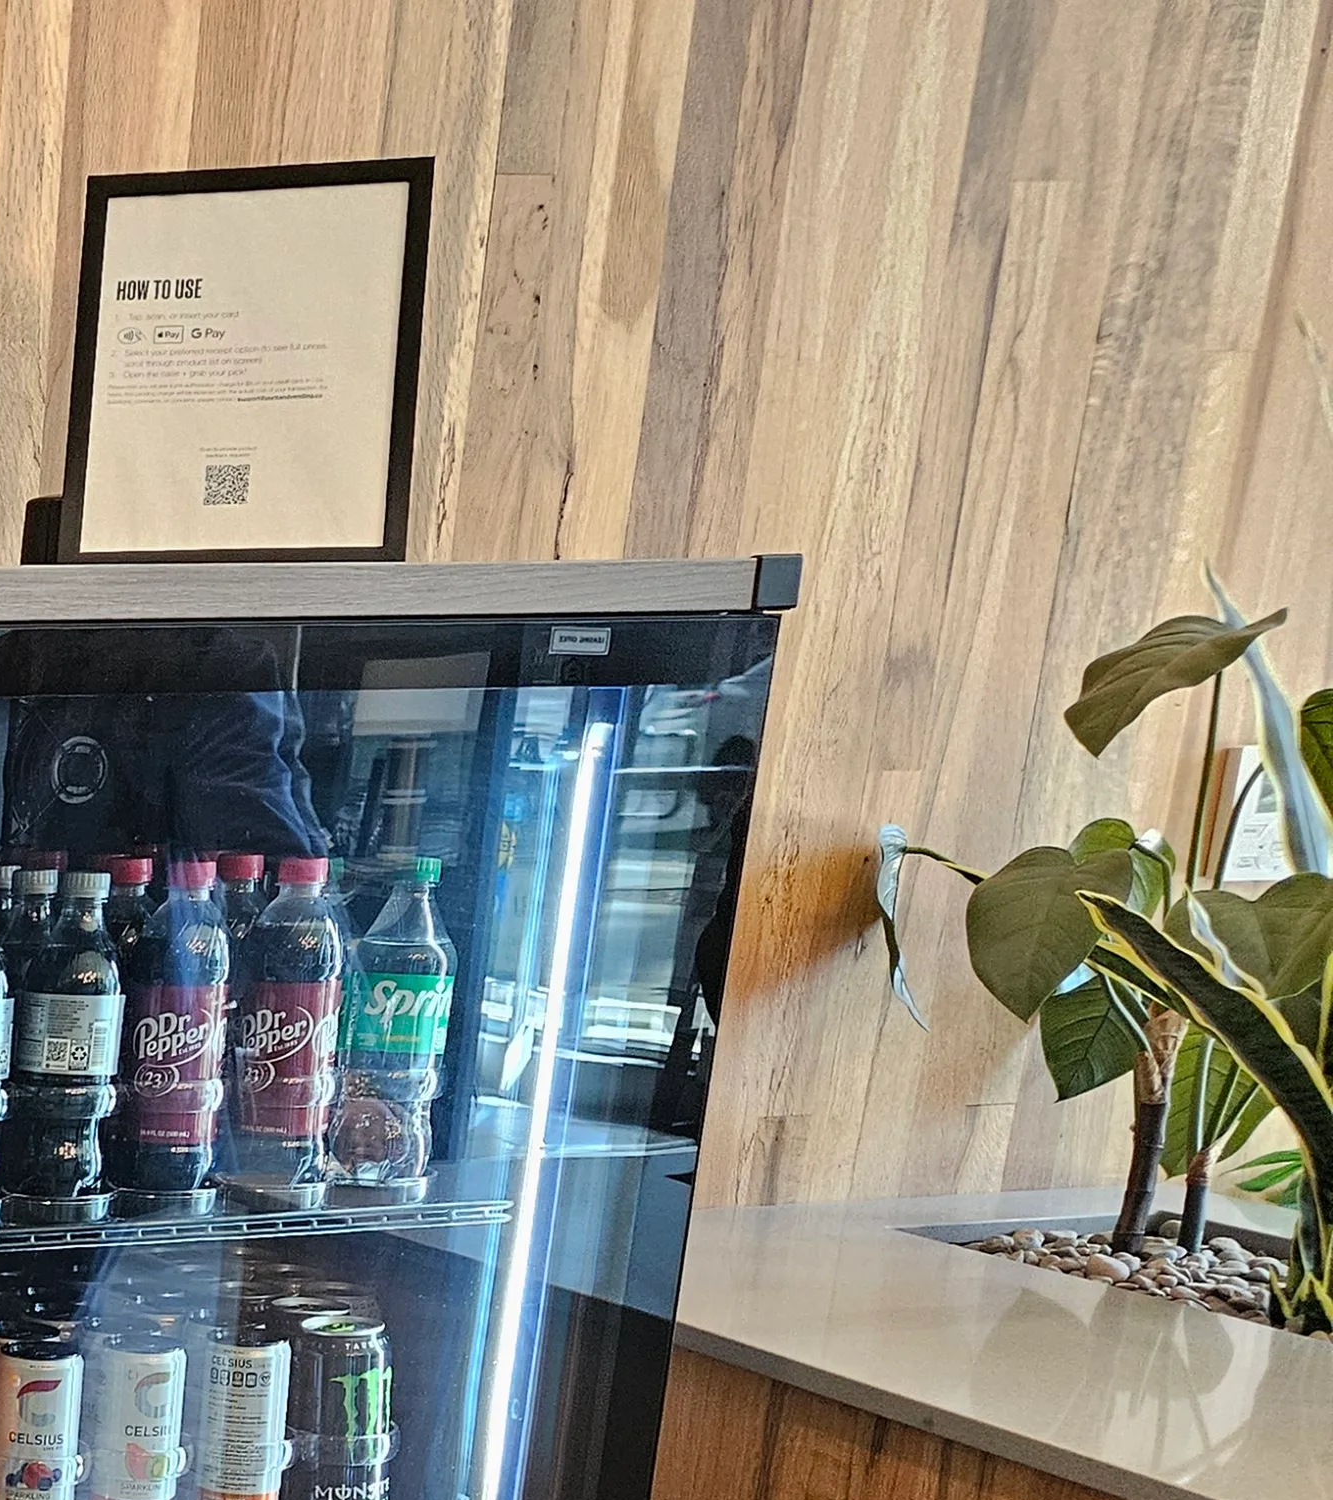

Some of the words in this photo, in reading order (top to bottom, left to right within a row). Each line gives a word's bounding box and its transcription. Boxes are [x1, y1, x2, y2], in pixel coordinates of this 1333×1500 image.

[116, 280, 149, 300] HOW
[154, 280, 170, 299] TO
[175, 278, 203, 299] USE
[165, 331, 178, 340] Pay
[205, 329, 225, 340] Pay
[151, 350, 167, 358] your
[169, 348, 204, 356] preferred
[146, 359, 174, 368] through
[176, 358, 205, 368] product
[123, 371, 144, 380] Open
[146, 370, 158, 378] the
[210, 370, 226, 378] your
[364, 980, 454, 1026] Sprit
[159, 1013, 192, 1037] Dr
[256, 1009, 286, 1031] Dr
[134, 1017, 210, 1061] Pepper
[145, 1071, 162, 1088] 23
[211, 1355, 253, 1369] CELSIUS
[124, 1424, 180, 1438] CELSI
[8, 1431, 64, 1447] CELSIUS
[5, 1490, 51, 1500] SPARKLING
